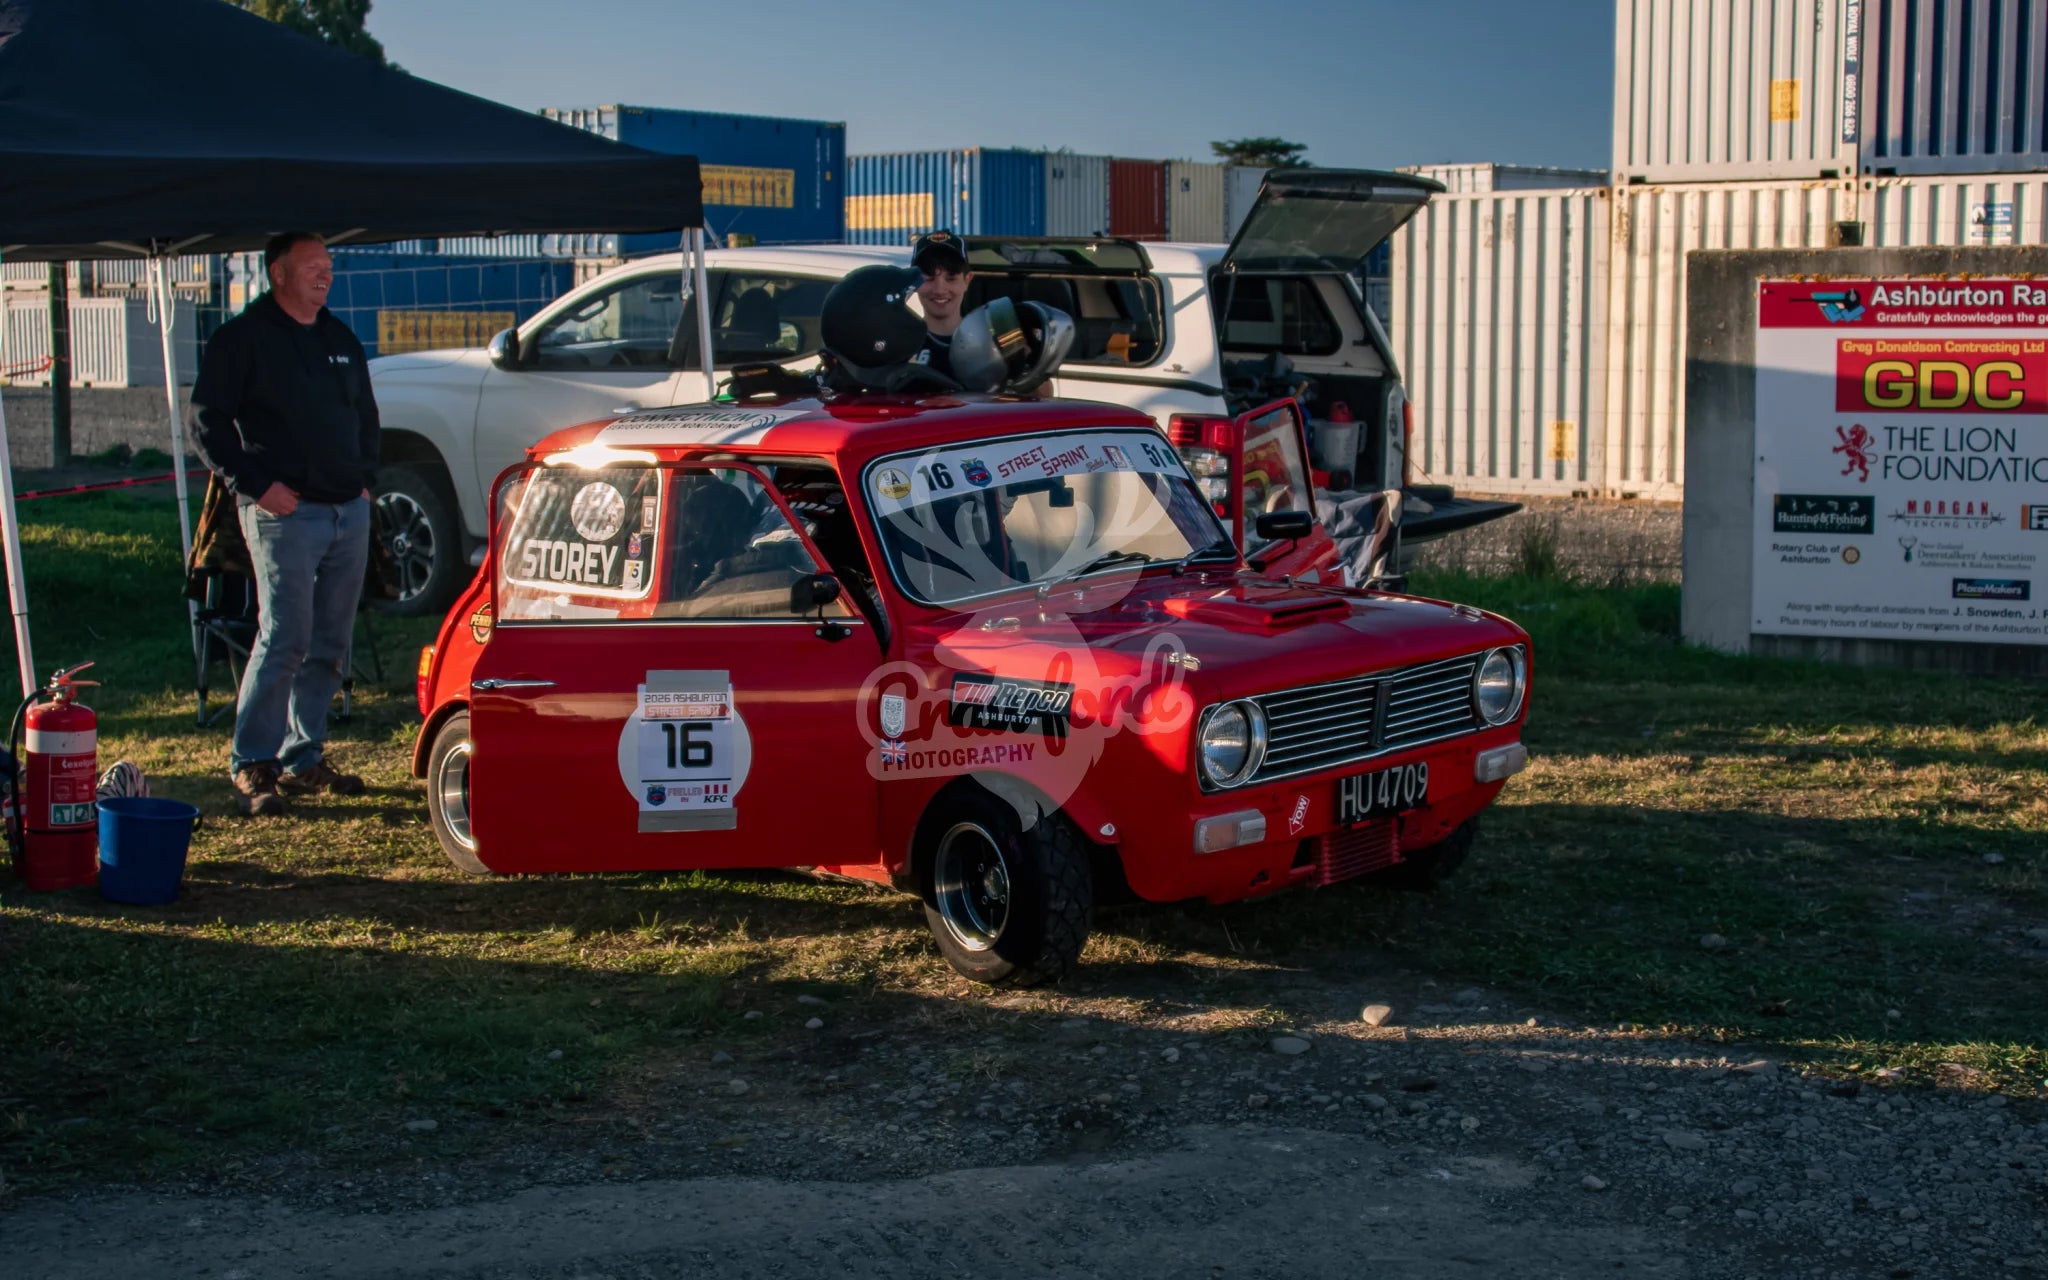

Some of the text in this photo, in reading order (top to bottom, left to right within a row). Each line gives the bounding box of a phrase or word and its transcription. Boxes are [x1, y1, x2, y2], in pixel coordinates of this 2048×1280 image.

[1847, 5, 1858, 62] ROYAL WOLF
[1845, 74, 1857, 98] 0800
[1871, 285, 2005, 307] Ashburton
[1877, 312, 1931, 325] Gratefully
[1933, 312, 2014, 325] acknowledges
[2016, 312, 2035, 323] the
[1842, 341, 2045, 356] Greg Donaldson Contracting Ltd
[1863, 359, 2026, 410] GDC
[1883, 427, 2017, 452] THE LION
[997, 445, 1047, 478] STREET
[1041, 445, 1090, 477] SPRINT
[916, 462, 955, 491] 16
[1907, 500, 1989, 515] MORGAN
[1772, 543, 1840, 554] Rotary Club of
[1780, 554, 1831, 565] Ashburton
[1981, 551, 2036, 563] Association
[521, 539, 619, 584] STOREY
[1956, 582, 2023, 596] PlaceMakers
[1786, 603, 1812, 614] Along
[1815, 603, 1833, 612] with
[1835, 604, 1880, 616] significant
[1881, 605, 1926, 615] donations
[1928, 606, 1949, 616] from
[1953, 607, 1964, 617] J.
[1966, 607, 2025, 620] Snowden,
[2028, 609, 2040, 619] J.
[1780, 616, 1799, 626] Plus
[1803, 618, 1828, 629] many
[1830, 618, 1856, 628] hours
[1859, 619, 1869, 628] of
[1870, 620, 1900, 630] labour
[1902, 621, 1914, 632] by
[1916, 621, 1960, 632] members
[1962, 623, 1973, 632] of
[1974, 623, 1990, 632] the
[1992, 624, 2041, 635] Ashburton
[644, 693, 728, 704] 2026 ASHBURTON
[997, 682, 1071, 714] Repco
[977, 712, 1039, 725] ASHBURTON
[661, 722, 714, 769] 16
[703, 794, 728, 804] KFC
[1340, 762, 1430, 819] HU 4709
[1293, 797, 1308, 826] TOW
